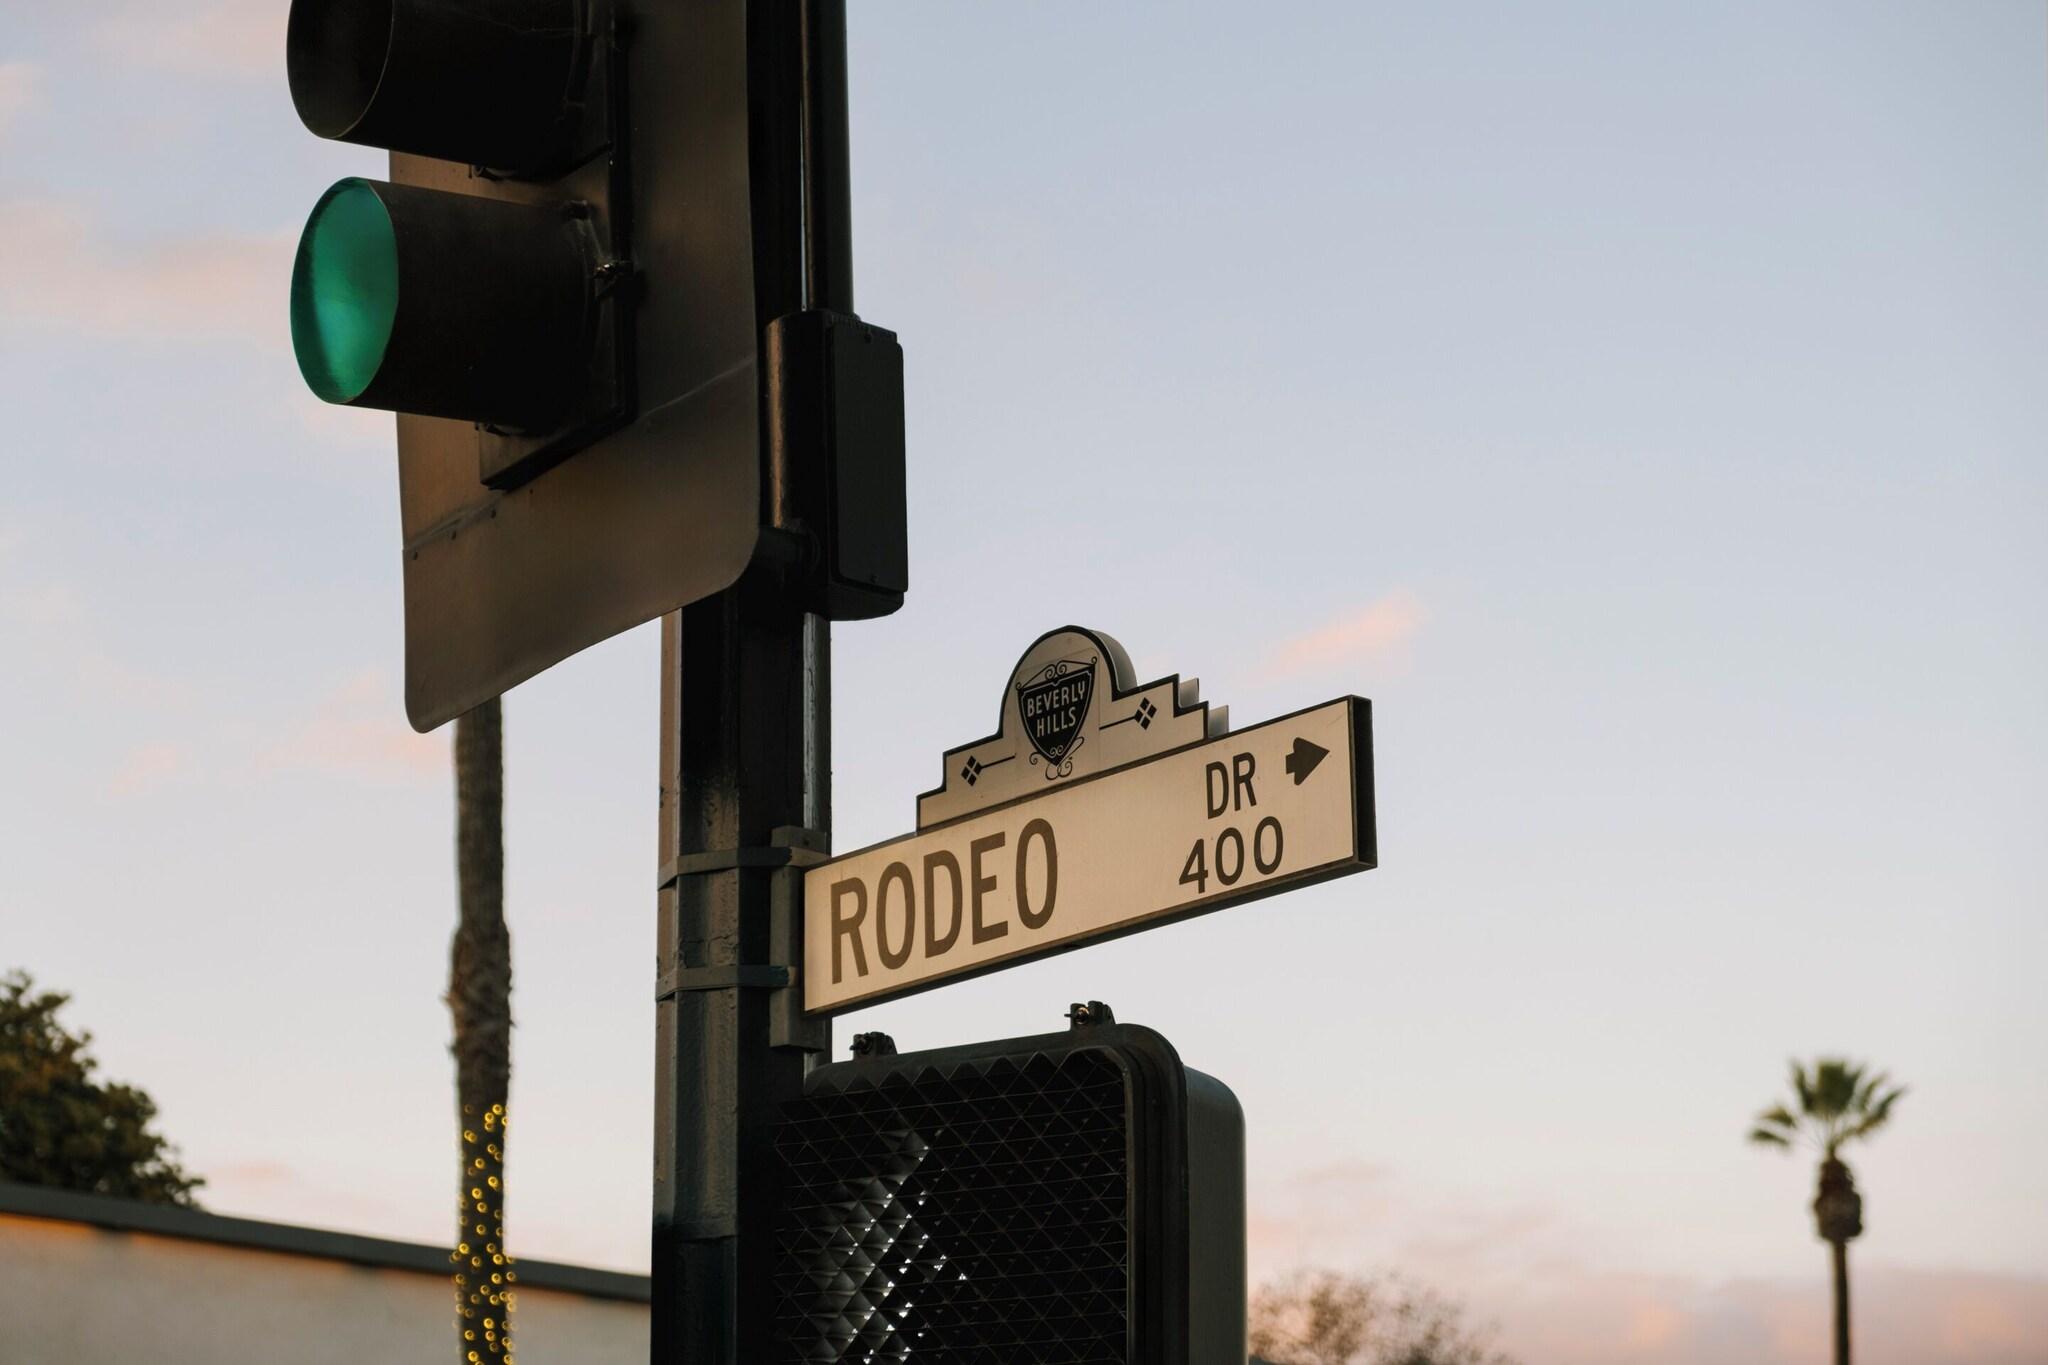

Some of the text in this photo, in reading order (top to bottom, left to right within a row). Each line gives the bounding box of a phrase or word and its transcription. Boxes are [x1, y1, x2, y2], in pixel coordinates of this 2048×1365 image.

[1027, 680, 1086, 717] BEVERLY
[1036, 706, 1077, 738] HILLS
[830, 752, 1257, 985] RODEO DR
[1178, 816, 1284, 894] 400
